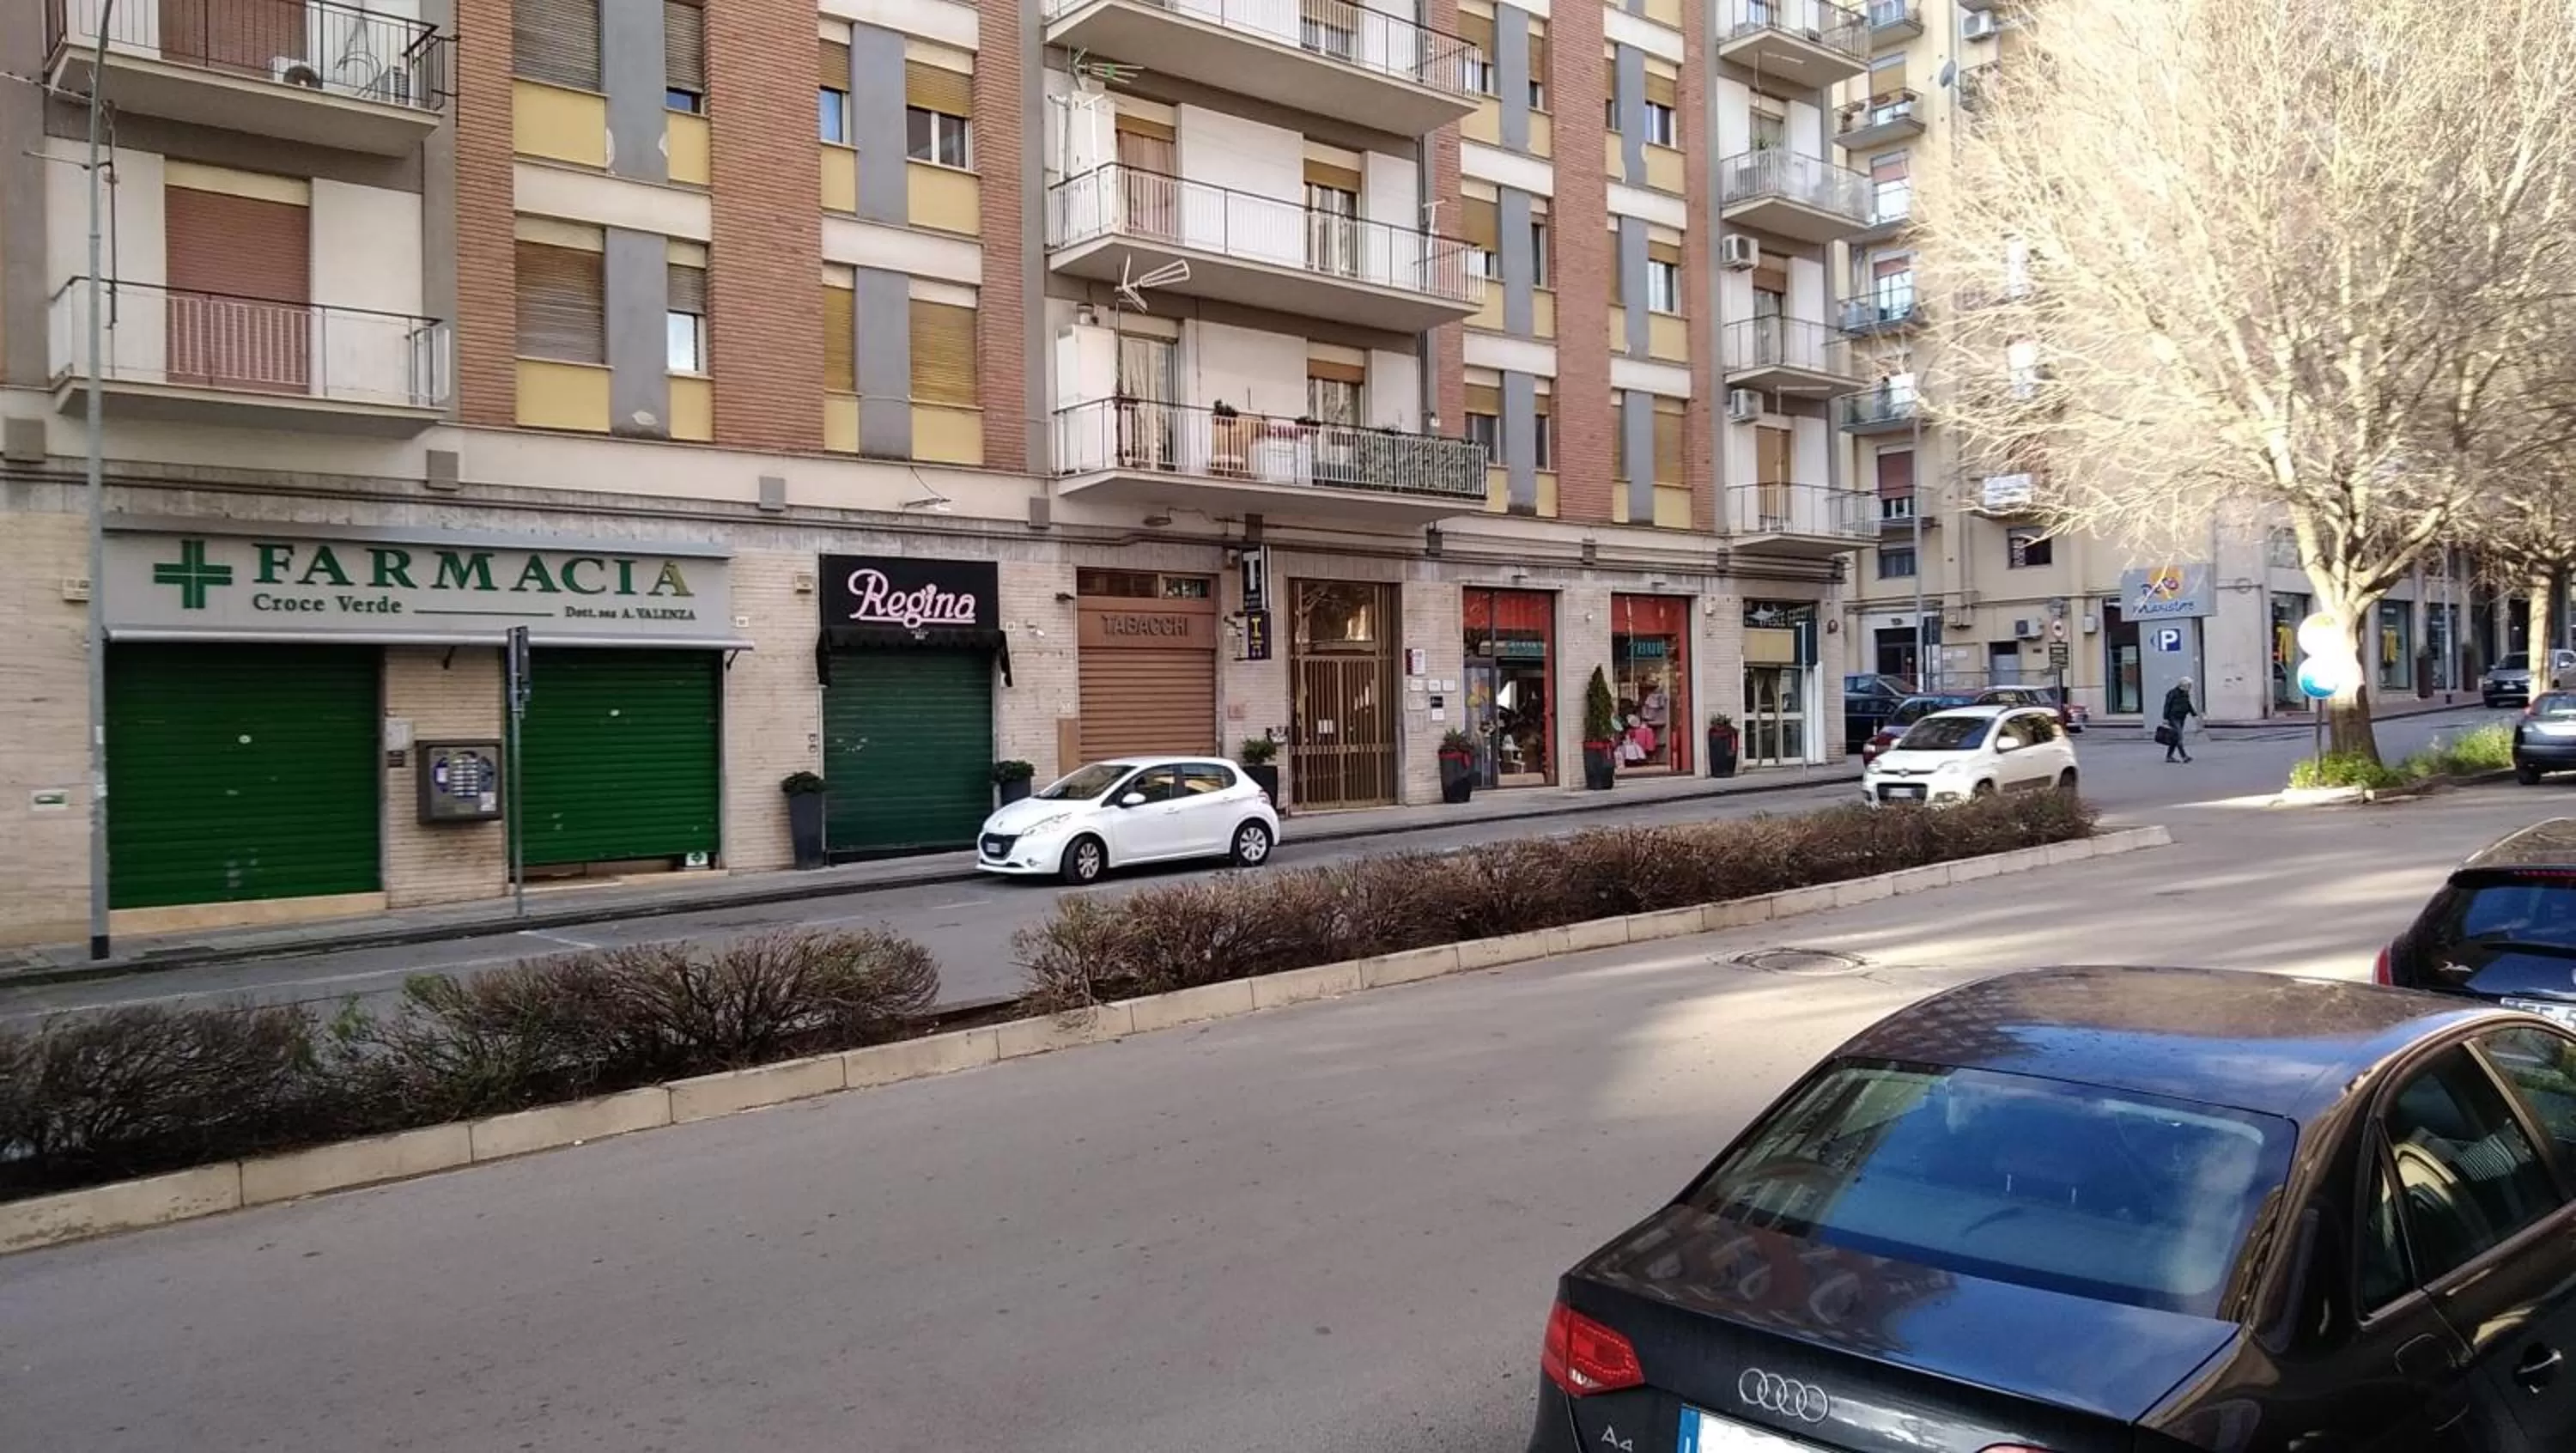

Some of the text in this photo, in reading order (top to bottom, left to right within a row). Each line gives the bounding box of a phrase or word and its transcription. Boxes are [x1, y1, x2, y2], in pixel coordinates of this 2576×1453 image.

[251, 542, 695, 597] FARMACIA
[252, 593, 403, 613] Croce Verde
[848, 568, 977, 629] Regina
[1100, 614, 1189, 637] TABACCHI
[2160, 629, 2178, 651] P
[1600, 1424, 1634, 1453] A4
